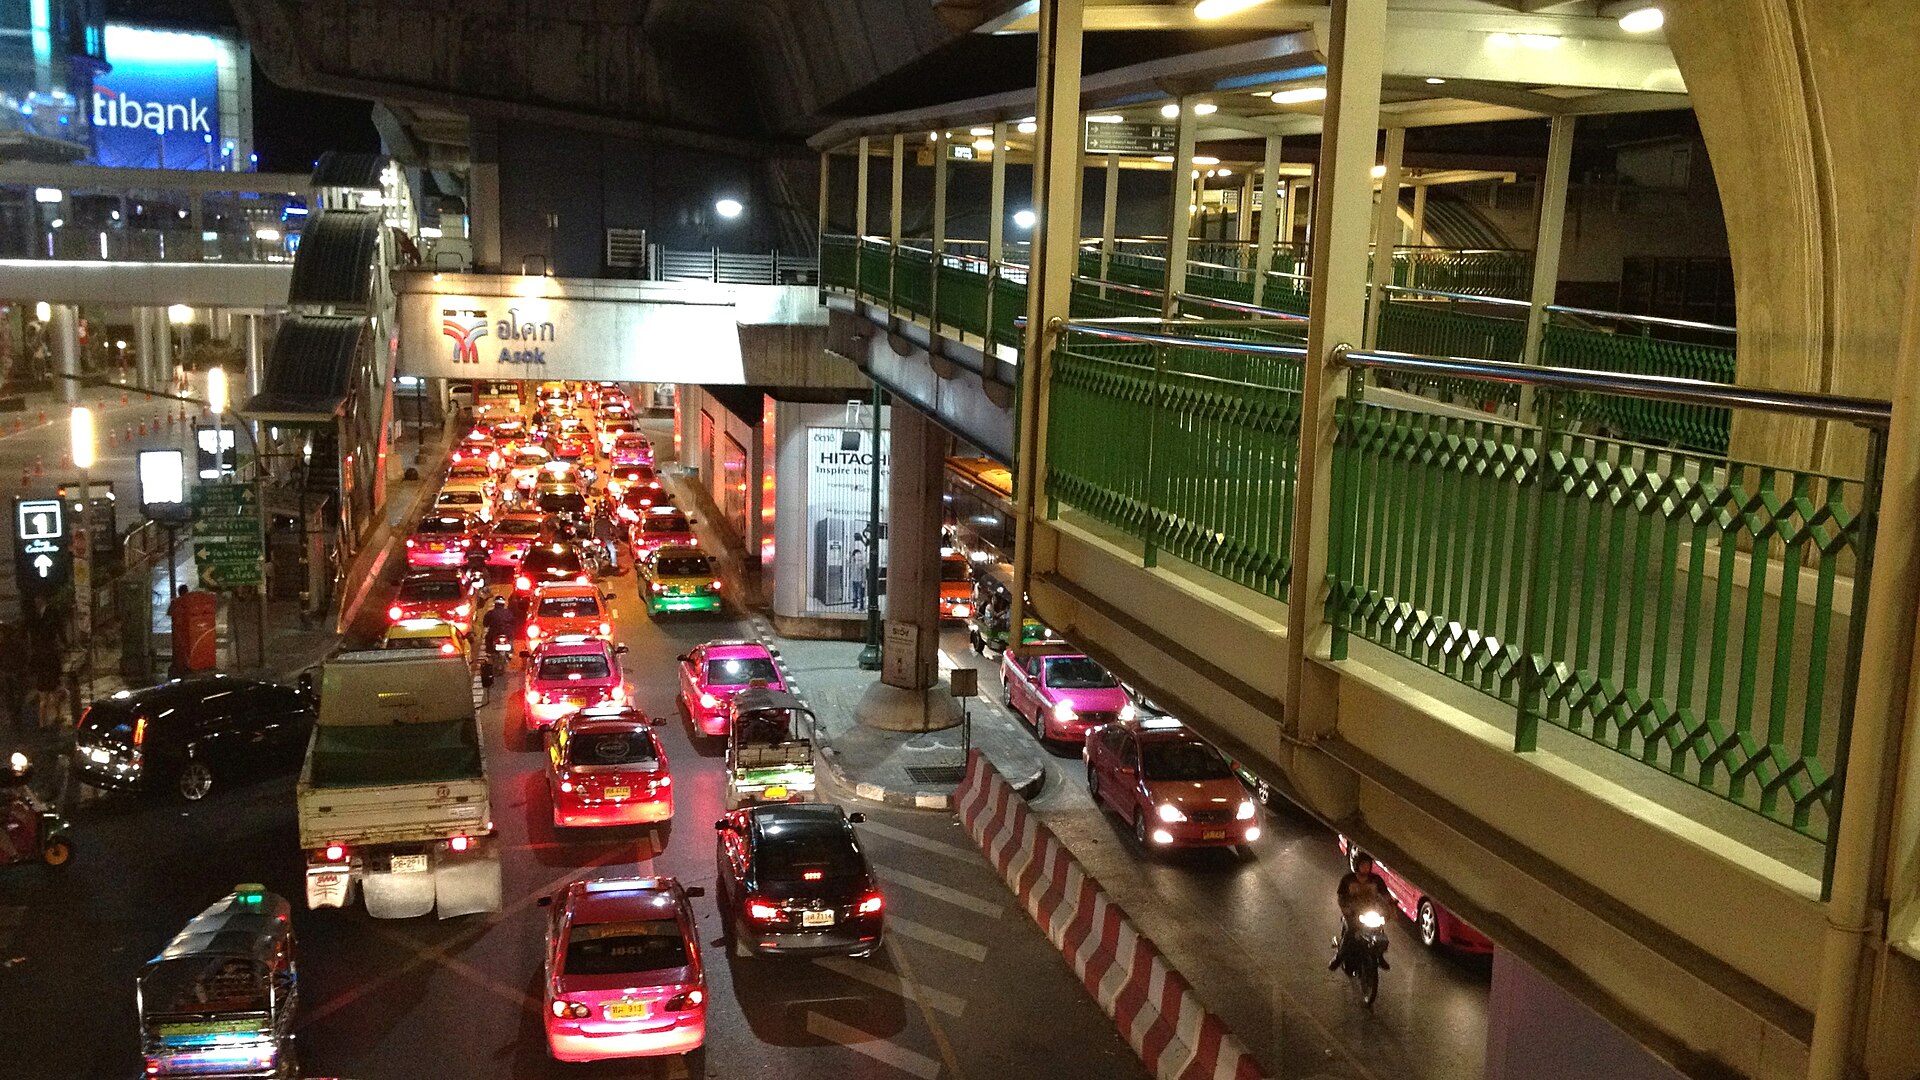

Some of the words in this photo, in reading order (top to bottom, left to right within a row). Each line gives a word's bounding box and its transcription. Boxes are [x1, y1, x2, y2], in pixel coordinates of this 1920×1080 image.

[496, 308, 555, 342] อโศก
[497, 347, 546, 364] Asok
[816, 466, 850, 476] Inspire
[854, 467, 869, 475] the
